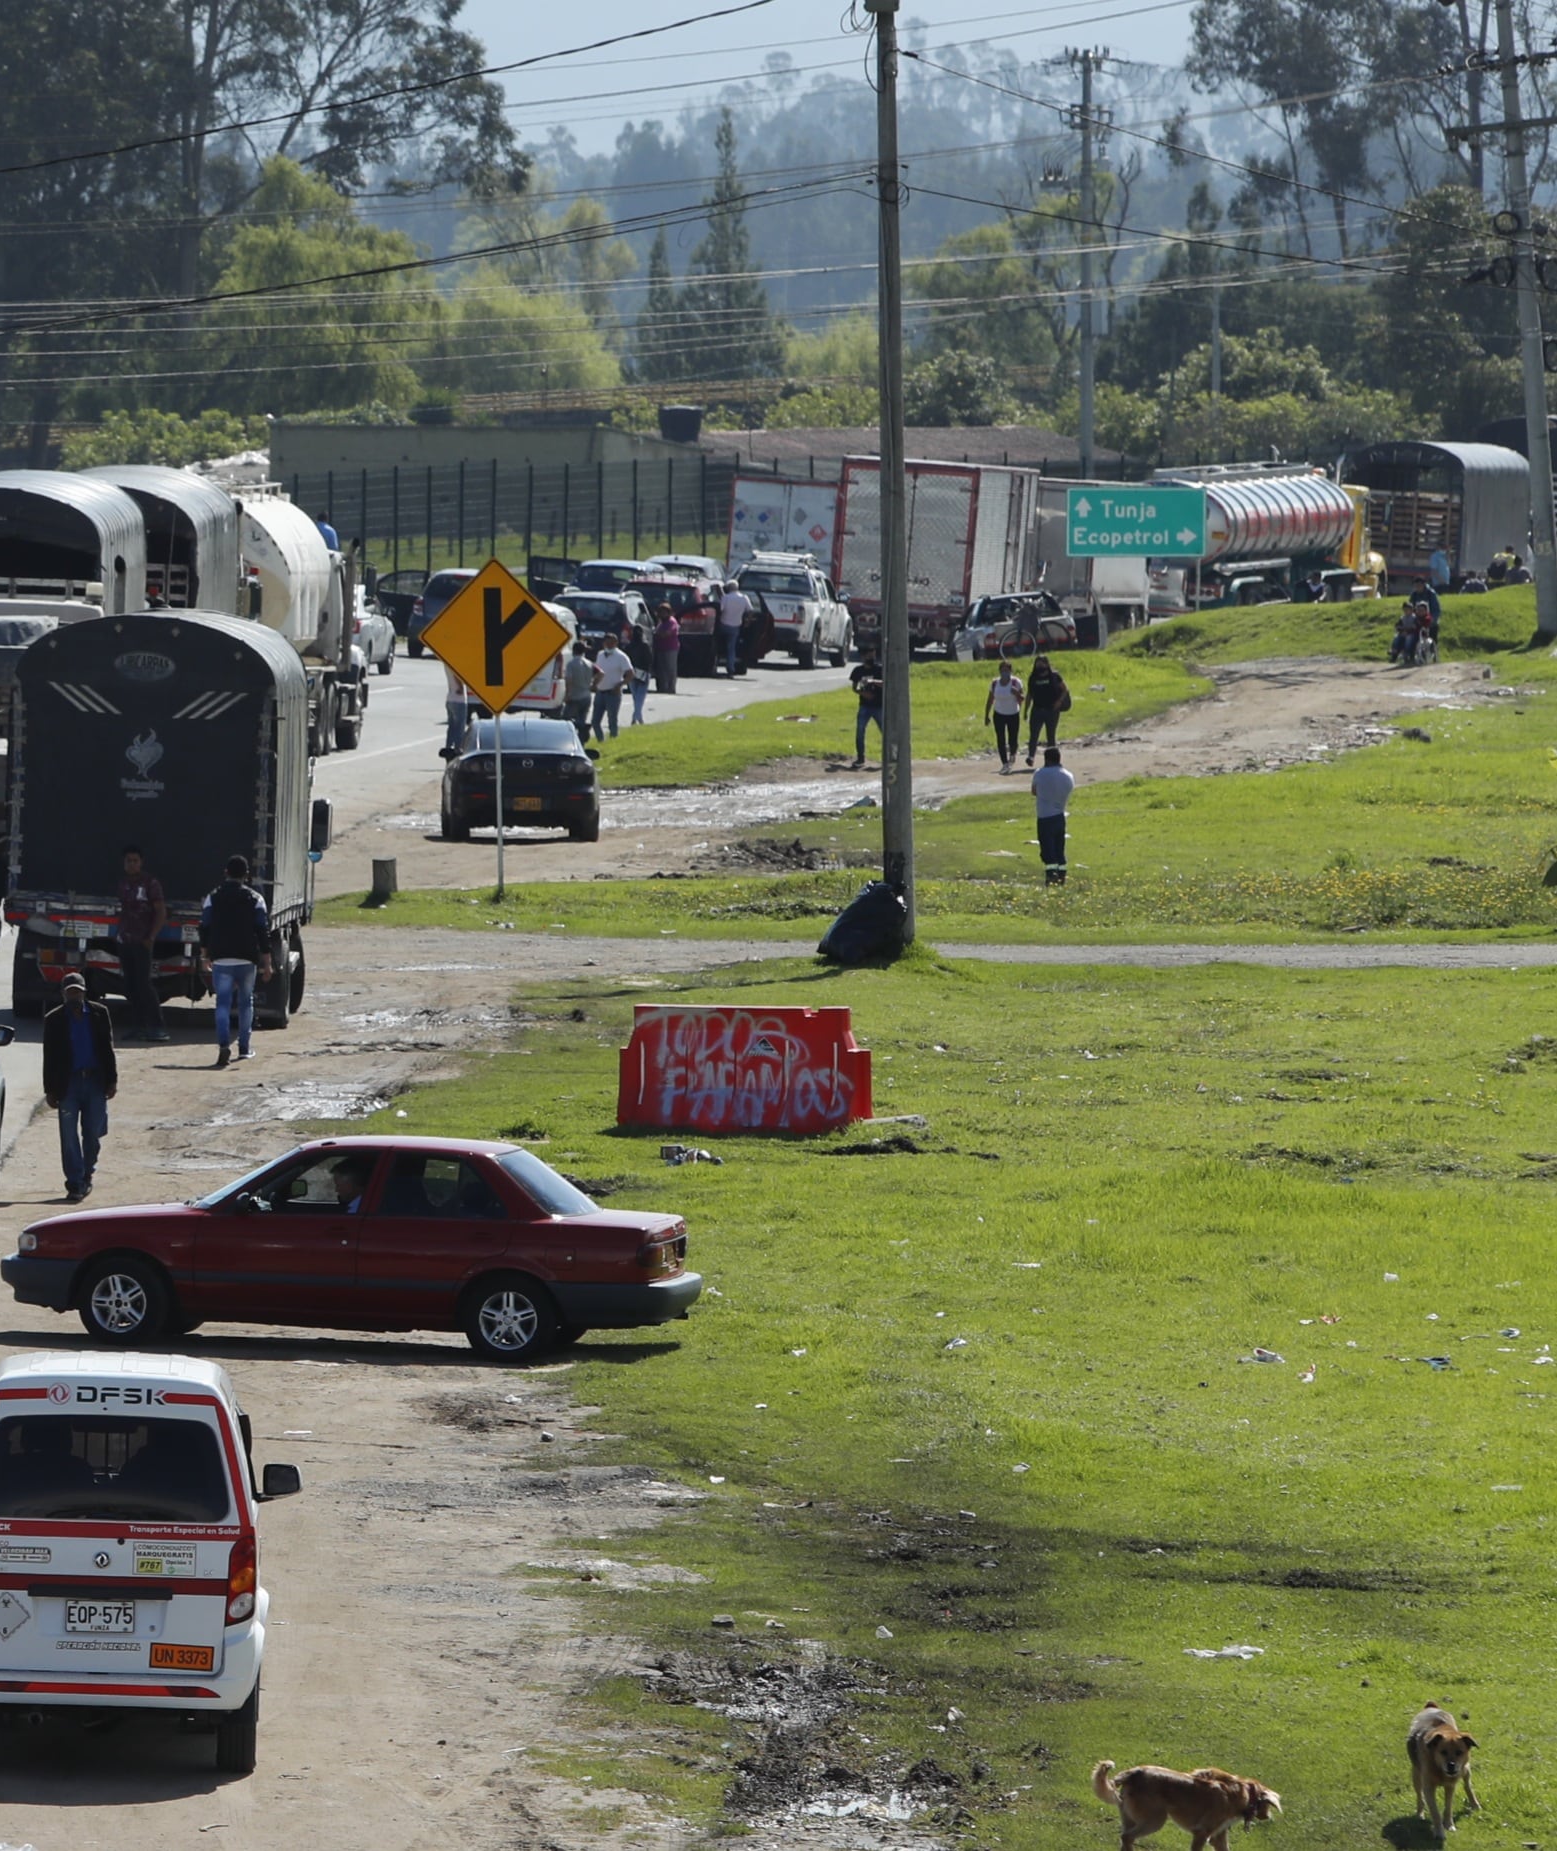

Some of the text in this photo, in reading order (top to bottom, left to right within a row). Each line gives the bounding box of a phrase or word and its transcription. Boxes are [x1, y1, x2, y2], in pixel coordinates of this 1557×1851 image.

[1101, 501, 1156, 522] Tunja
[1074, 528, 1170, 547] Ecopetrol
[76, 1386, 165, 1405] DFSK
[129, 1525, 172, 1537] Transporte
[173, 1527, 206, 1538] Especial
[218, 1528, 241, 1536] Salud
[2, 1626, 9, 1635] 6
[56, 1640, 141, 1652] OPERACIÓN NACIONAL
[154, 1648, 209, 1666] UN 3373
